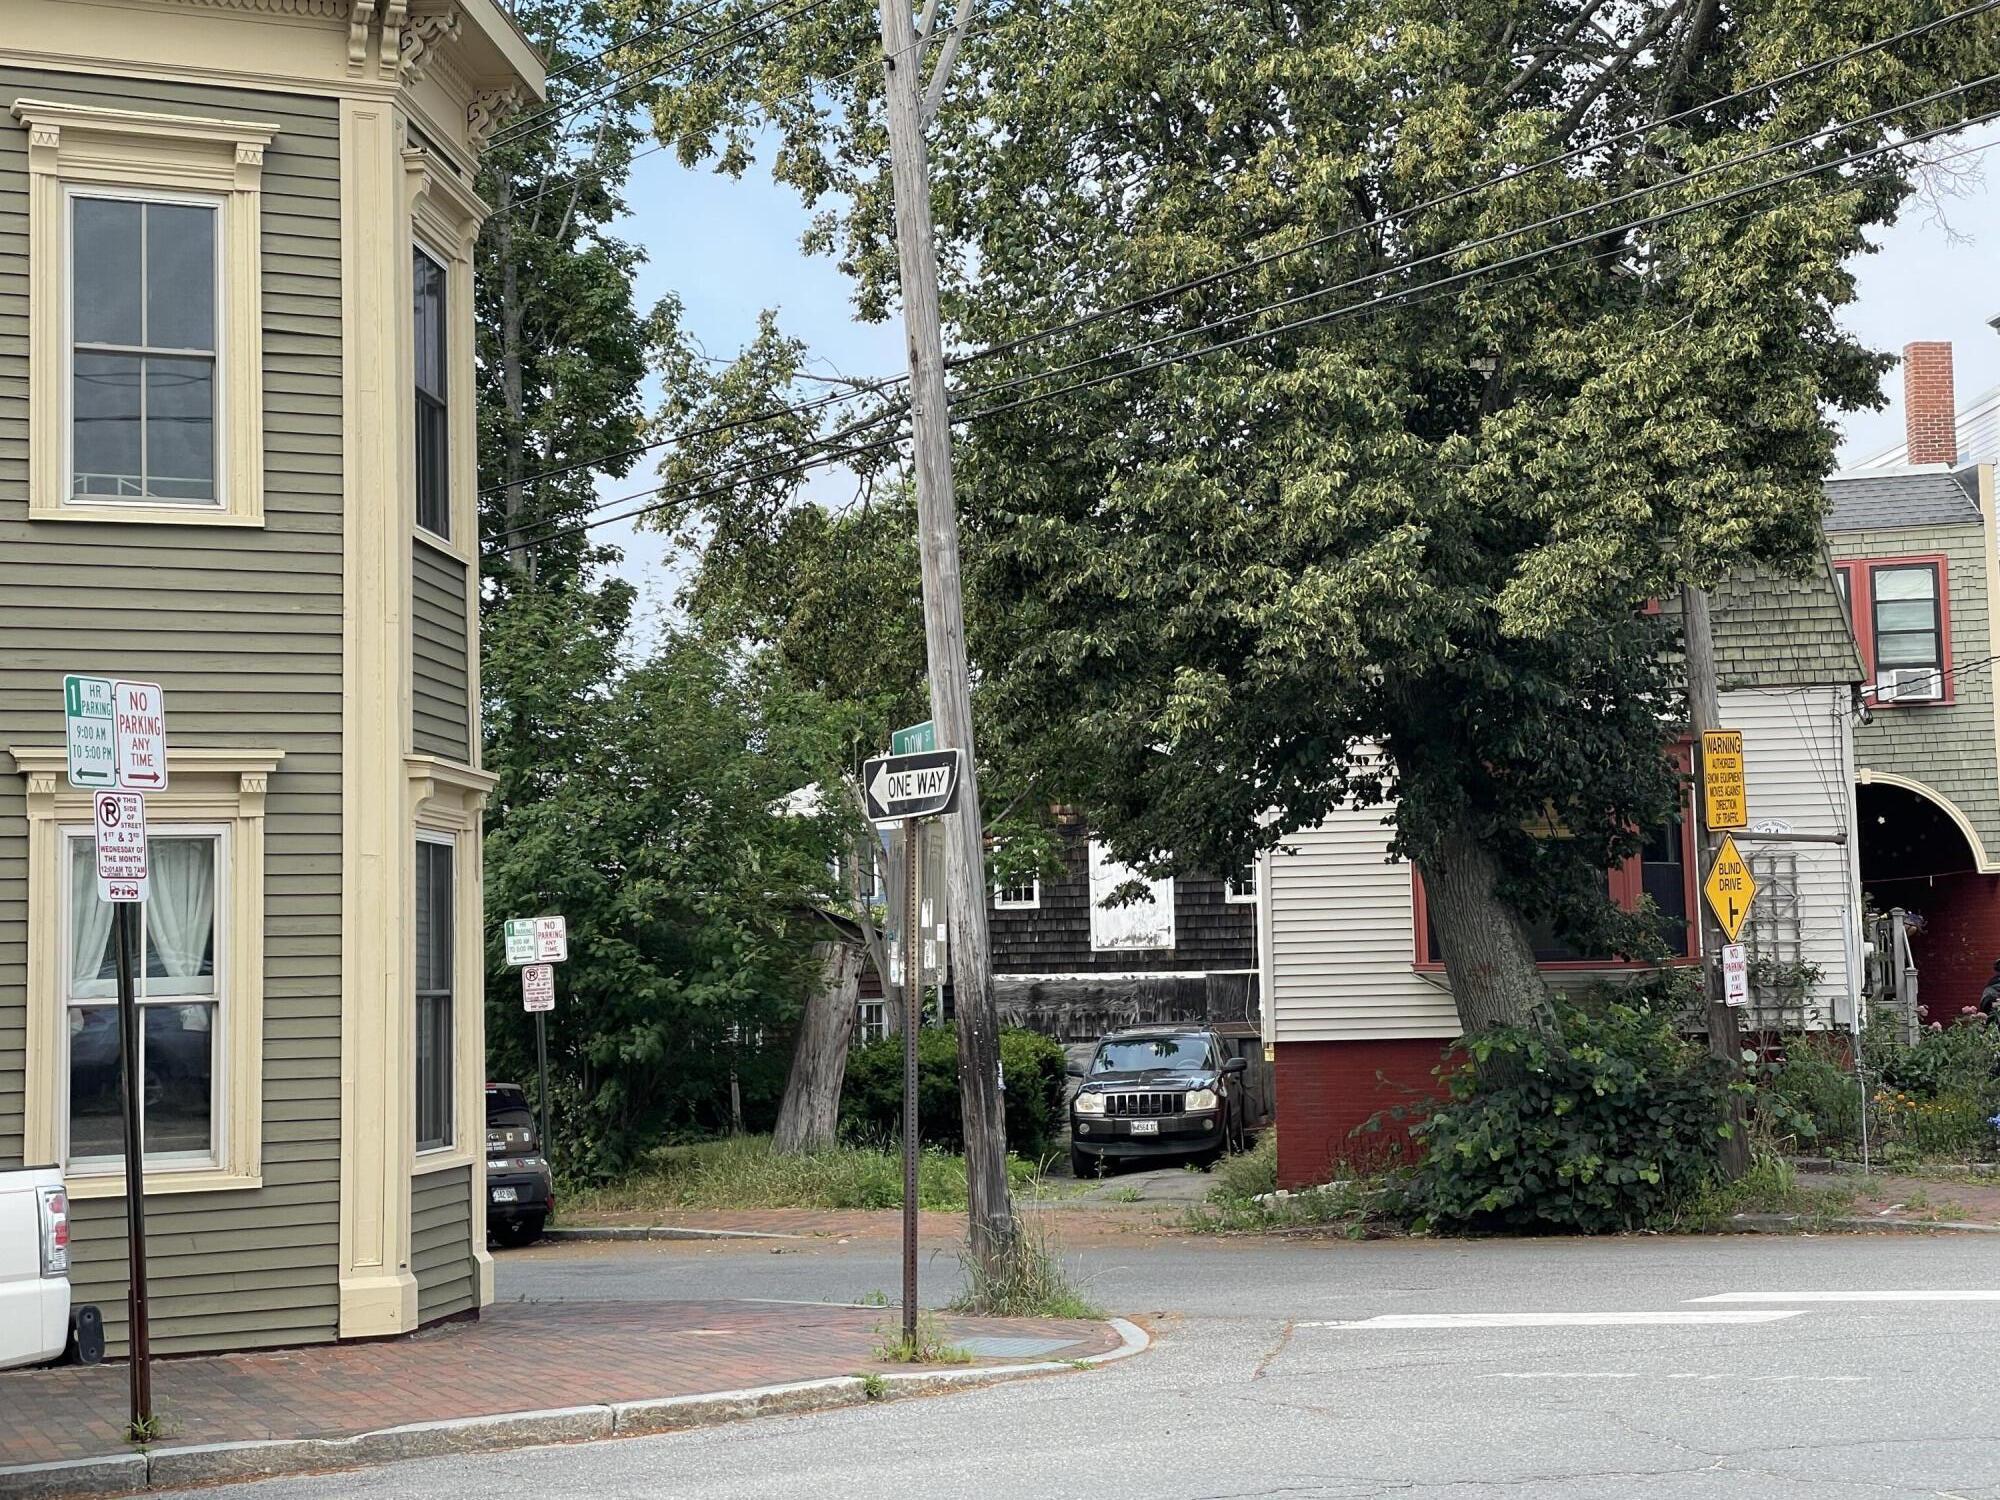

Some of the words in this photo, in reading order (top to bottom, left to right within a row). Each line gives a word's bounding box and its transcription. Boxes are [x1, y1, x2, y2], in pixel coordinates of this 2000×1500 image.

[70, 684, 77, 711] 1
[89, 685, 101, 698] HR
[81, 700, 112, 716] PARKING
[130, 692, 147, 711] NO
[120, 714, 160, 736] PARKING
[76, 725, 94, 739] 9:00
[95, 727, 107, 741] AM
[132, 738, 151, 751] ANY
[904, 733, 922, 754] DOW
[925, 729, 931, 742] ST
[1705, 736, 1741, 754] WARNING
[73, 744, 82, 758] TO
[85, 745, 101, 760] 5:00
[102, 747, 113, 760] PM
[131, 753, 154, 767] TIME
[1712, 758, 1736, 769] AUTHORIZED
[888, 774, 912, 798] ONE
[917, 770, 945, 794] WAY
[1707, 772, 1719, 784] SNOW
[1720, 771, 1742, 783] EQUIPMENT
[1709, 785, 1724, 797] MOVES
[1725, 785, 1741, 796] AGAINST
[1715, 799, 1737, 810] DIRECTION
[1715, 813, 1722, 824] OF
[1722, 812, 1739, 823] TRAFFIC
[118, 832, 124, 842] &
[1718, 863, 1741, 875] BLIND
[1719, 878, 1742, 891] DRIVE
[544, 921, 555, 930] NO
[538, 930, 563, 939] PARKING
[1730, 948, 1738, 958] NO
[1725, 961, 1744, 971] PARKING
